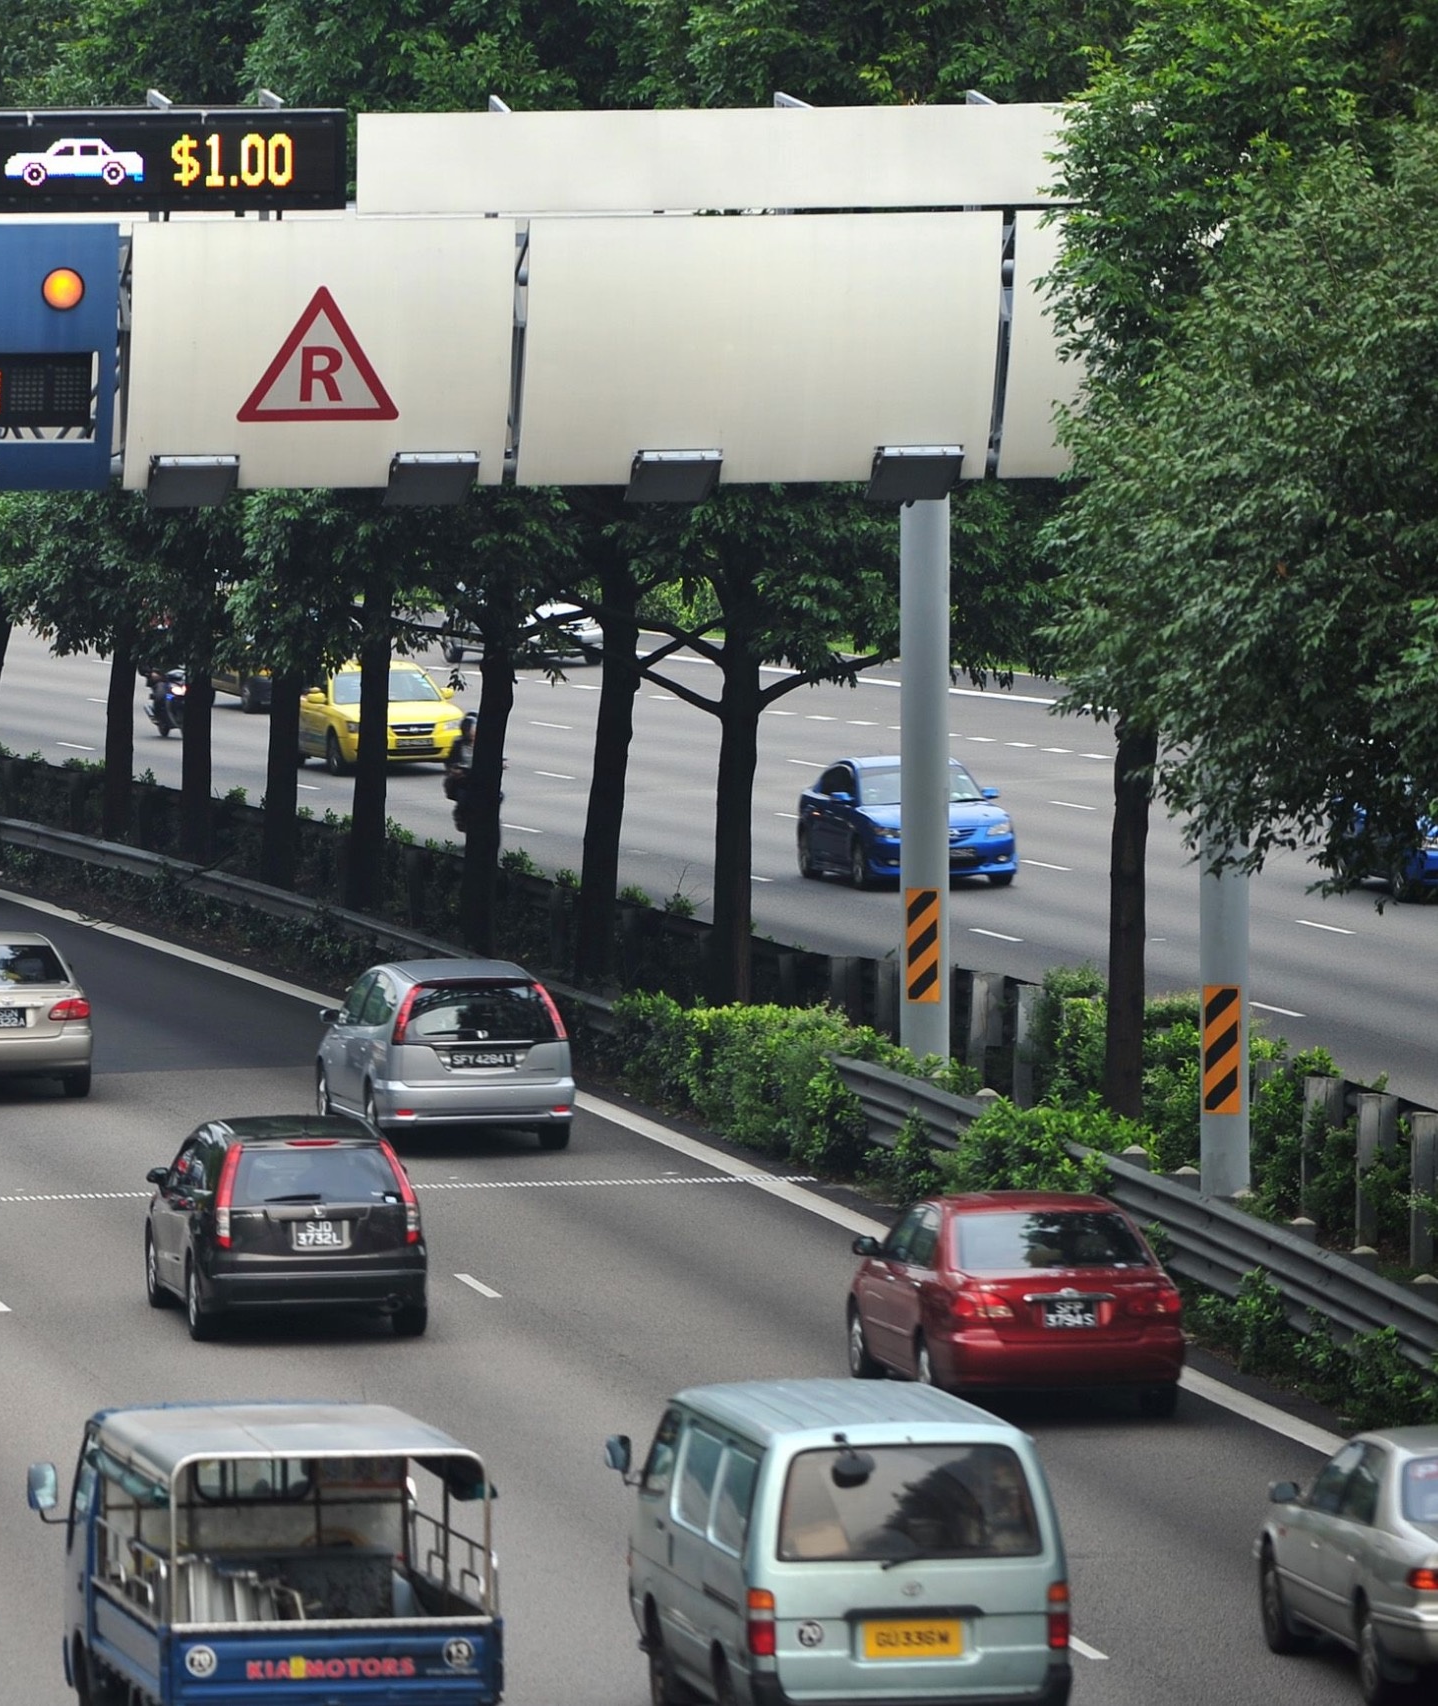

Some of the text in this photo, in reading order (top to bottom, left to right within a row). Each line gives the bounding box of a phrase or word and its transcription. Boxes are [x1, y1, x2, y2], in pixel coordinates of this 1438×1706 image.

[171, 133, 294, 187] $1.00
[299, 346, 343, 402] R
[452, 1054, 513, 1065] SFY4284T
[305, 1221, 332, 1233] SJD
[297, 1233, 342, 1245] 3732L
[246, 1657, 415, 1680] KIA MOTORS
